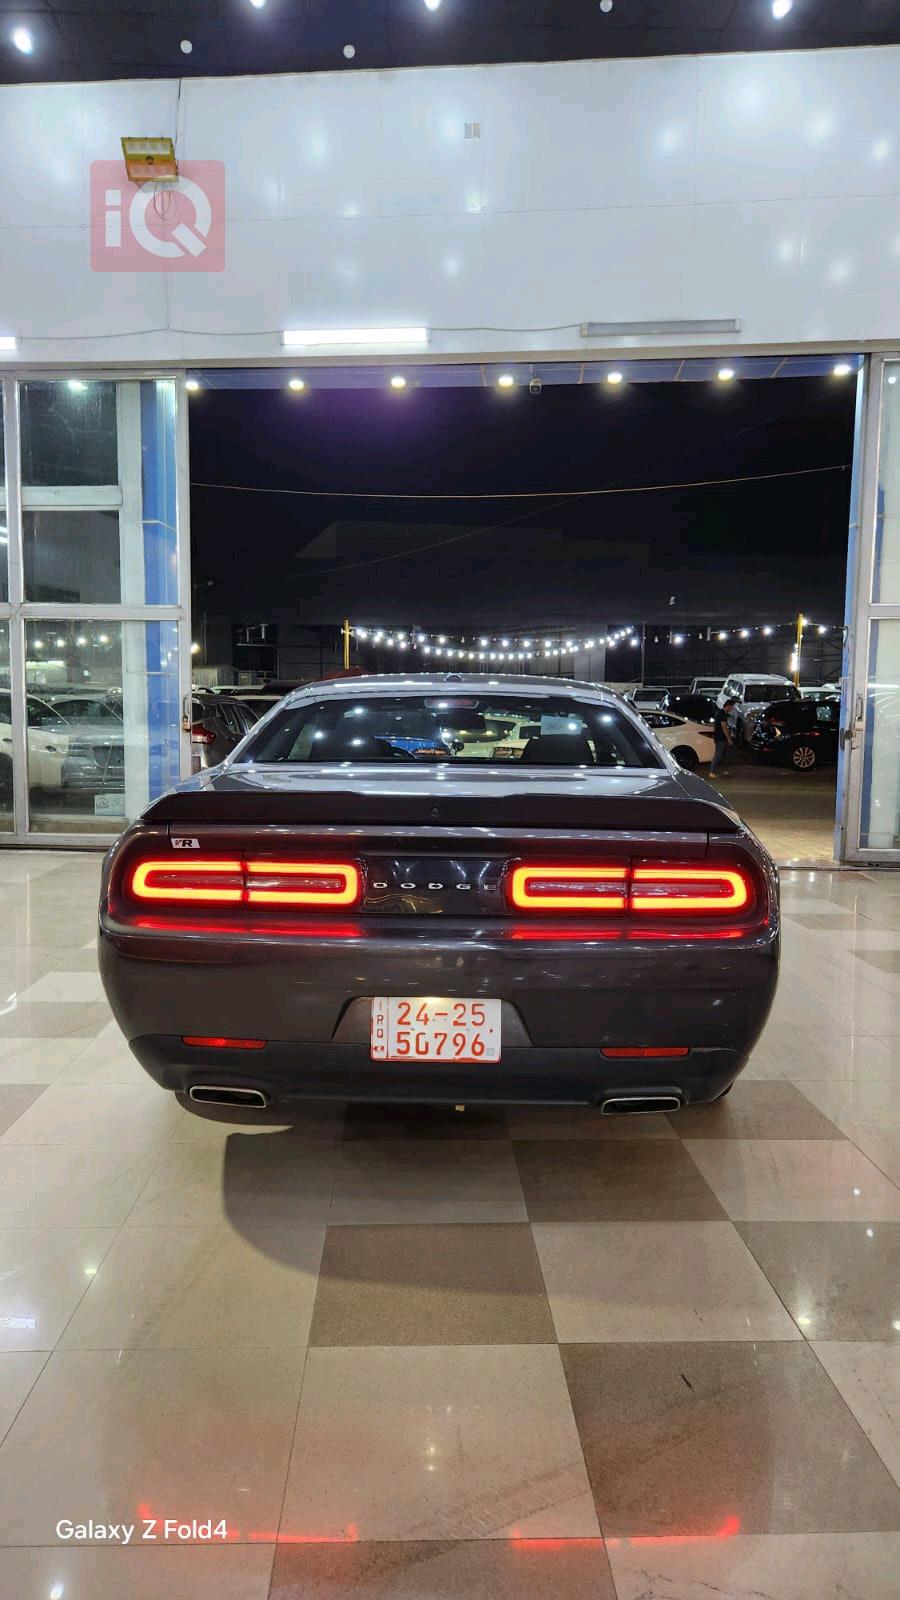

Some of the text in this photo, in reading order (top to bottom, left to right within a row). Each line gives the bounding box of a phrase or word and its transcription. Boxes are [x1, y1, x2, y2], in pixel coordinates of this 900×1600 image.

[373, 882, 497, 891] DODGE
[397, 1002, 485, 1027] 24-25
[396, 1031, 485, 1057] 50796
